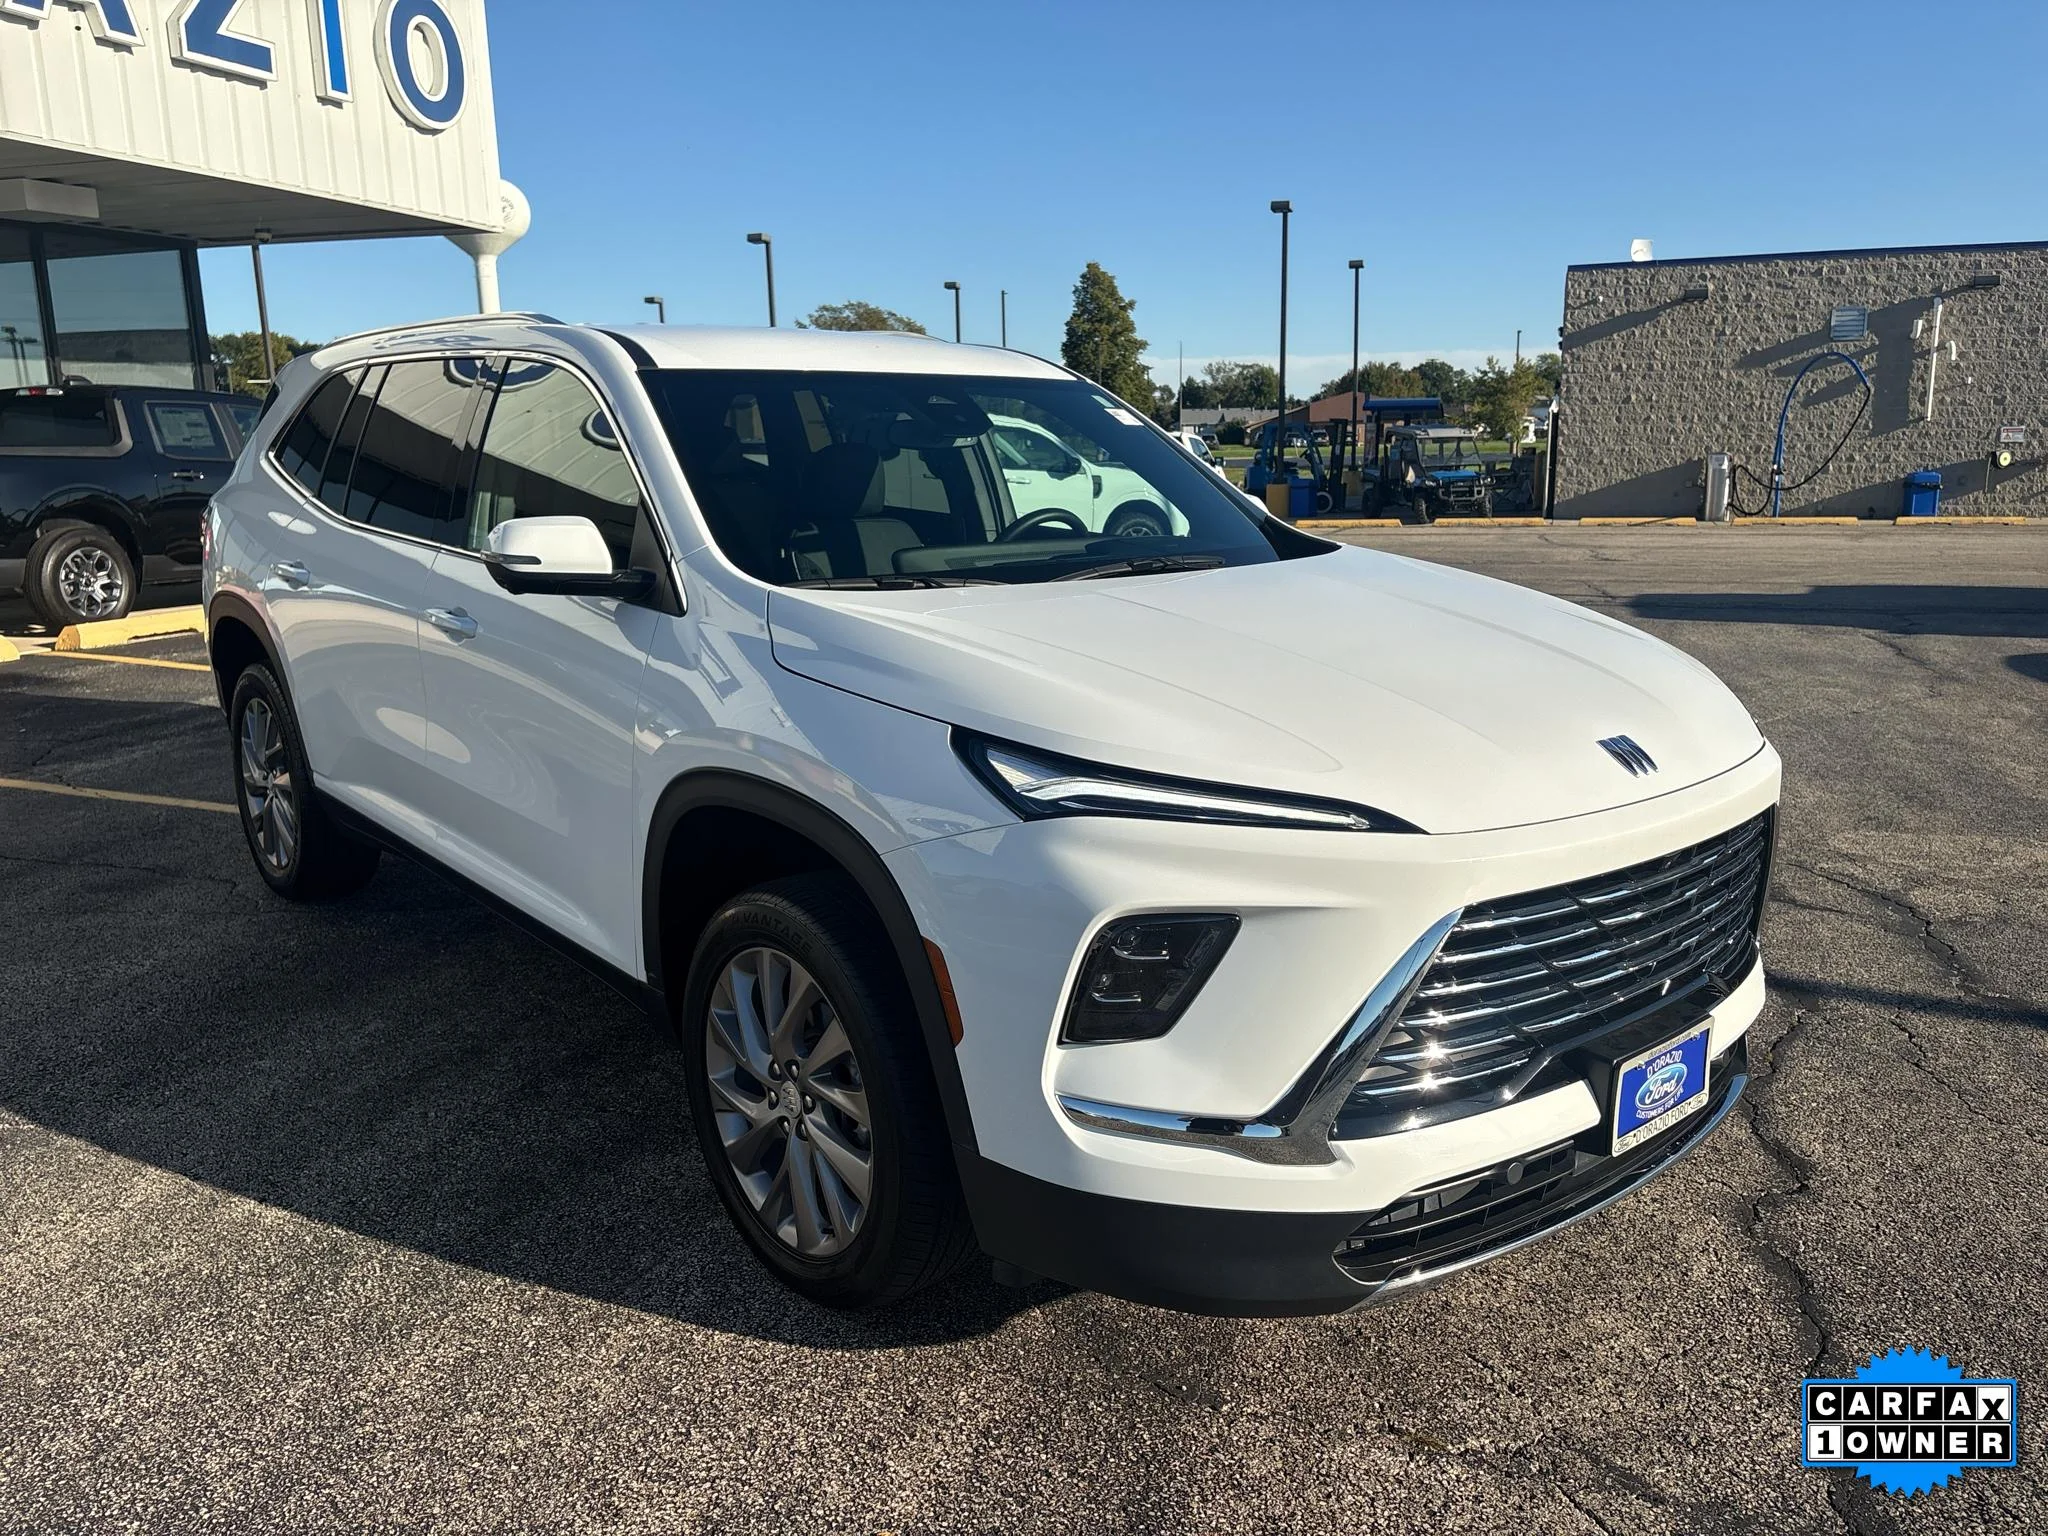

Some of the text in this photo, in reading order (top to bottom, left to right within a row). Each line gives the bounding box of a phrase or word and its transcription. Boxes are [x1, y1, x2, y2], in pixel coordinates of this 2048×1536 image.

[0, 0, 468, 131] ZIO
[1647, 1050, 1683, 1079] D'ORAZIO
[1645, 1071, 1679, 1104] Ford
[1635, 1103, 1688, 1143] D'ORAZIO FORD
[1636, 1105, 1665, 1119] CUSTOMERS
[1665, 1098, 1674, 1109] FOR
